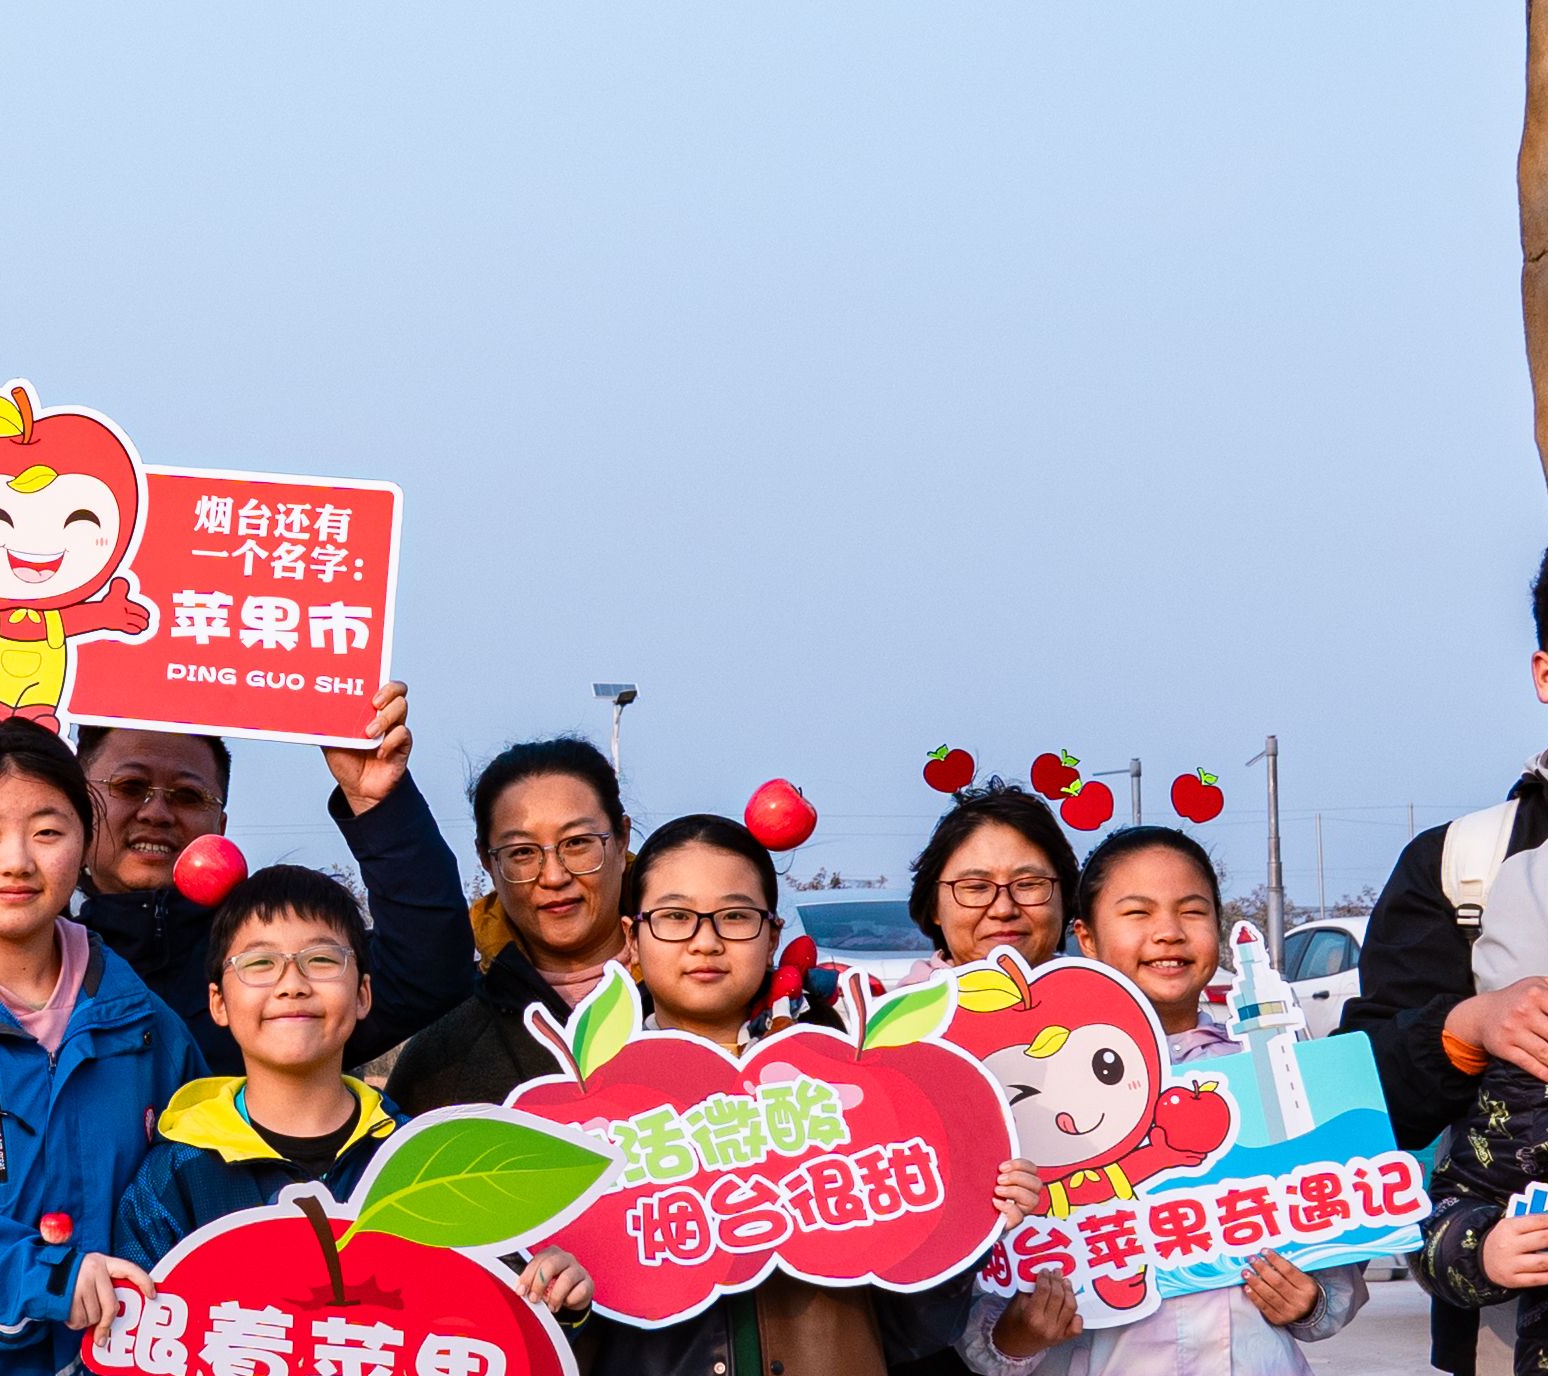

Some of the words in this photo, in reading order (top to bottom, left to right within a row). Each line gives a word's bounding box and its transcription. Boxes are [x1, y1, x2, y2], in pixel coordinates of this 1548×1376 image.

[194, 495, 352, 543] 烟台还有
[190, 539, 366, 583] 一个名字：
[170, 589, 373, 655] 苹果市
[246, 669, 304, 692] GUO
[314, 675, 365, 697] SHI
[594, 1079, 848, 1186] 活微酸
[631, 1144, 940, 1262] 烟台很甜
